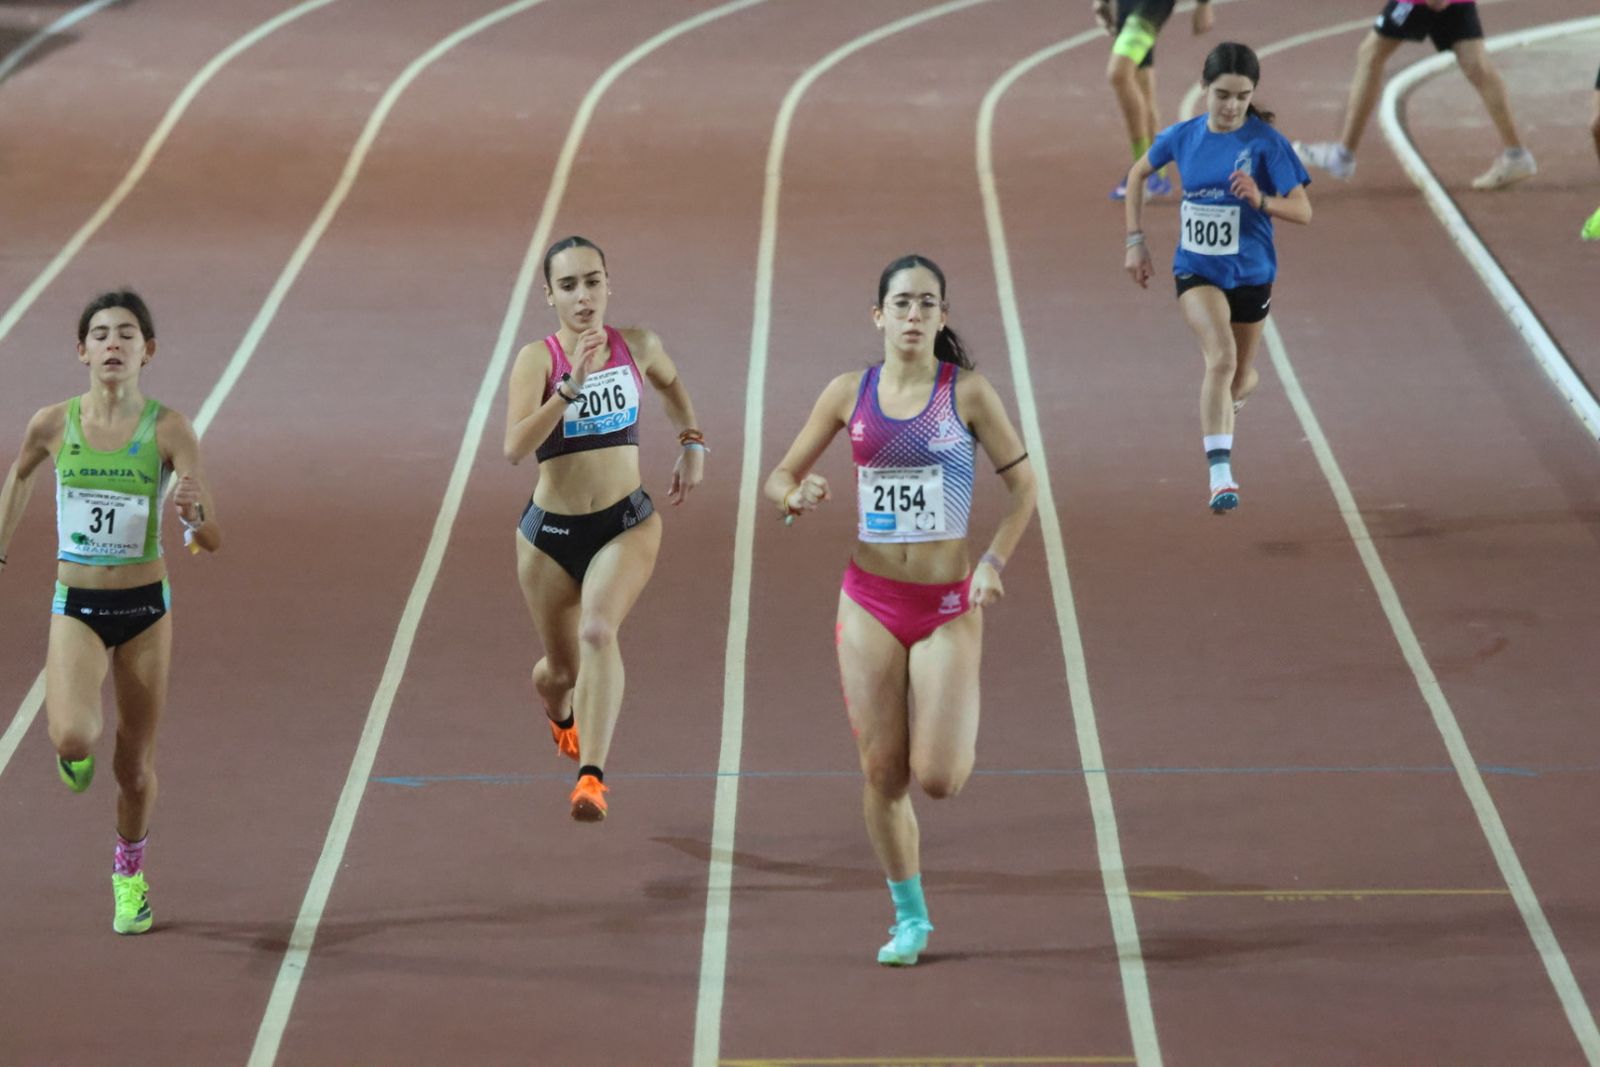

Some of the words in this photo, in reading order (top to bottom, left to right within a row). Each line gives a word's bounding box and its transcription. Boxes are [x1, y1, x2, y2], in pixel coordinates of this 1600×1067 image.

[1185, 218, 1232, 247] 1803
[576, 384, 626, 419] 2016
[63, 470, 75, 478] LA
[80, 468, 135, 477] GRANJA
[873, 484, 926, 512] 2154
[89, 507, 116, 534] 31
[75, 545, 127, 554] ARANDA
